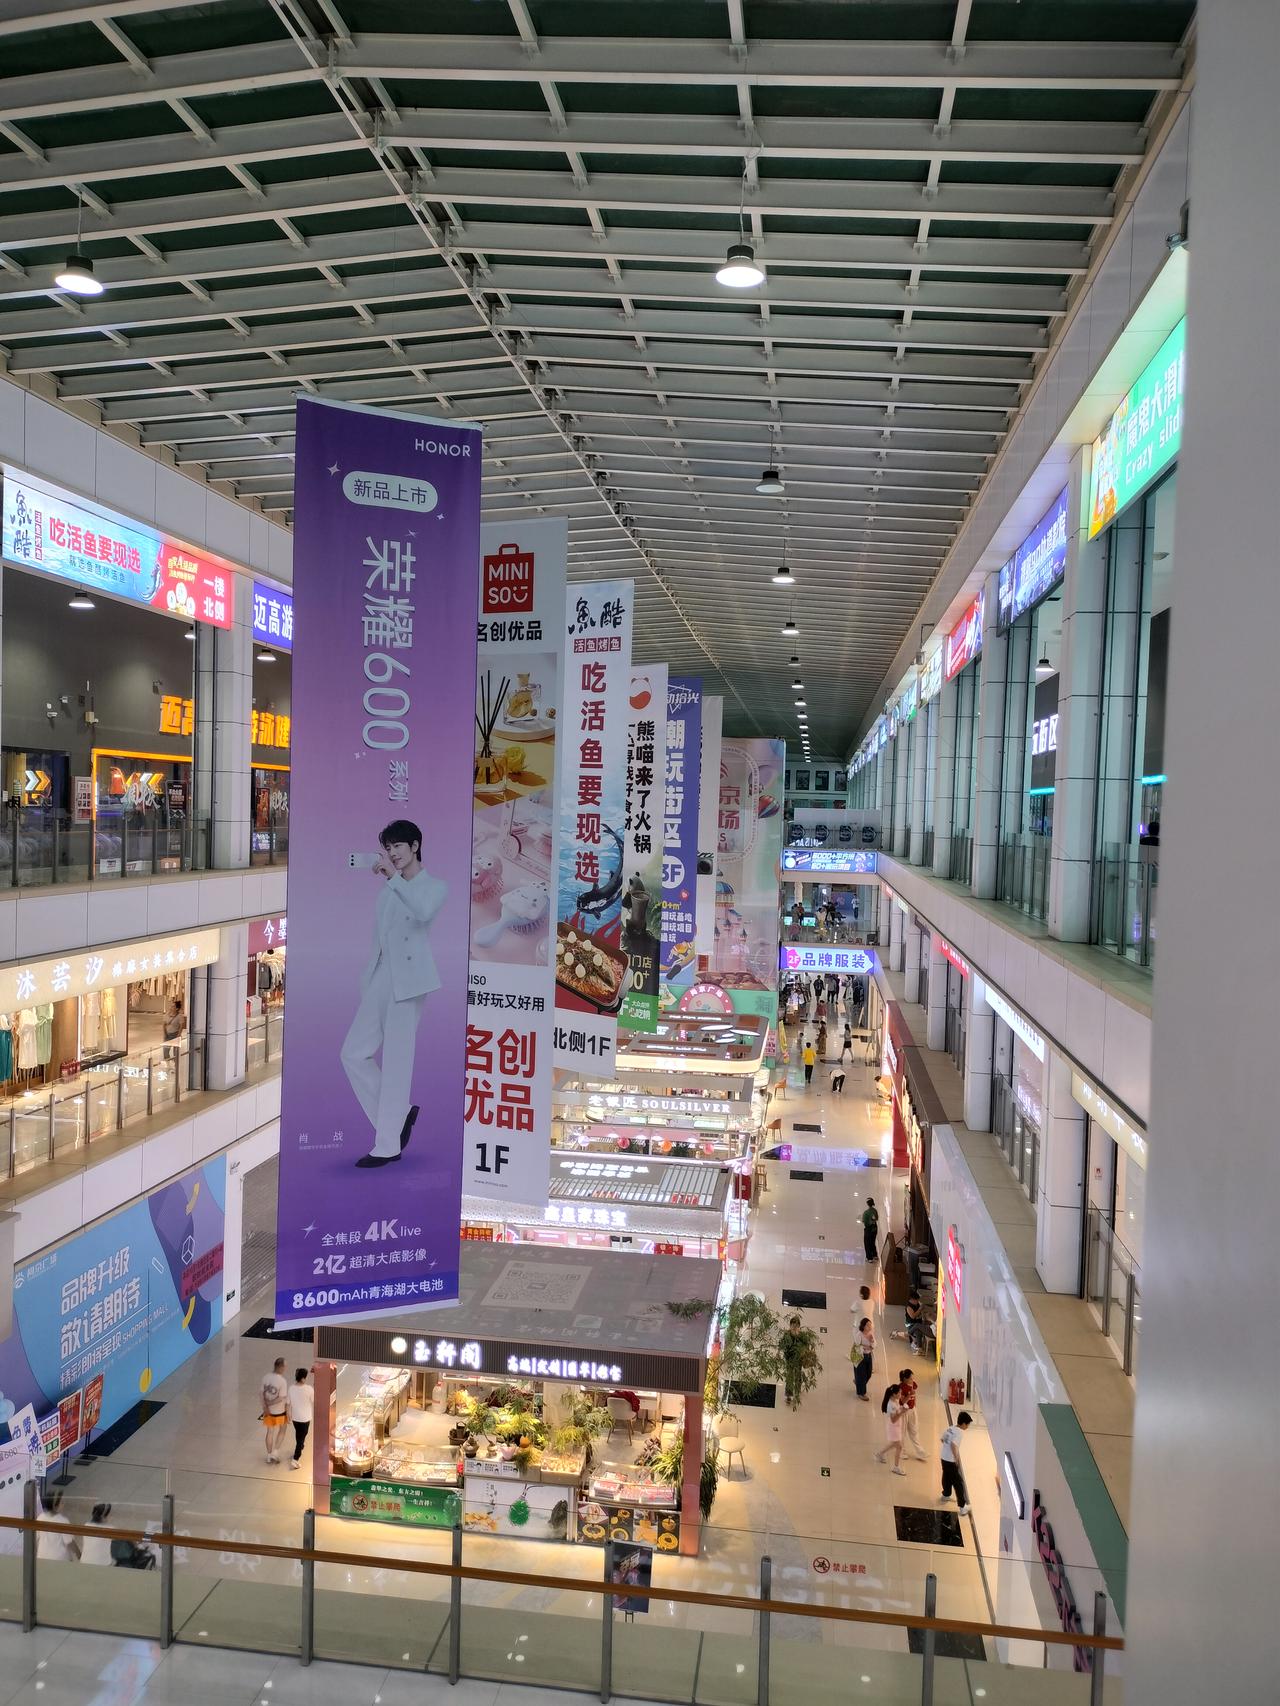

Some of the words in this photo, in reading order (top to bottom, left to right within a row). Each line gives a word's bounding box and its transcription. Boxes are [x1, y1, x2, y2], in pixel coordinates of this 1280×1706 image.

[415, 438, 471, 457] HONOR
[353, 478, 427, 505] 新品上市
[49, 516, 141, 574] 吃活鱼要现选
[488, 562, 529, 582] MINI
[203, 576, 225, 598] 一楼
[203, 597, 225, 622] 北侧
[477, 620, 543, 642] 名创优品
[574, 637, 621, 653] 活鱼烤鱼
[574, 661, 607, 885] 吃活鱼要现选
[633, 720, 655, 854] 熊喵来了火锅
[628, 954, 652, 969] 门店
[802, 952, 866, 969] 品牌服装
[467, 990, 545, 1013] 看好玩又好用
[465, 1024, 537, 1079] 名创
[553, 1025, 611, 1057] 北侧1F
[642, 1099, 731, 1114] SOULSILVER
[475, 1142, 511, 1175] 1F
[321, 1231, 361, 1247] 全焦段
[364, 1219, 399, 1242] 4K
[400, 1225, 422, 1237] live
[312, 1254, 347, 1276] 2亿
[349, 1248, 428, 1270] 超清大底影像
[61, 1246, 131, 1317] 品牌升级
[292, 1278, 444, 1309] 8600mAh青海湖大电池
[60, 1277, 141, 1361] 敬请期待
[832, 1561, 866, 1574] 禁止攀爬
